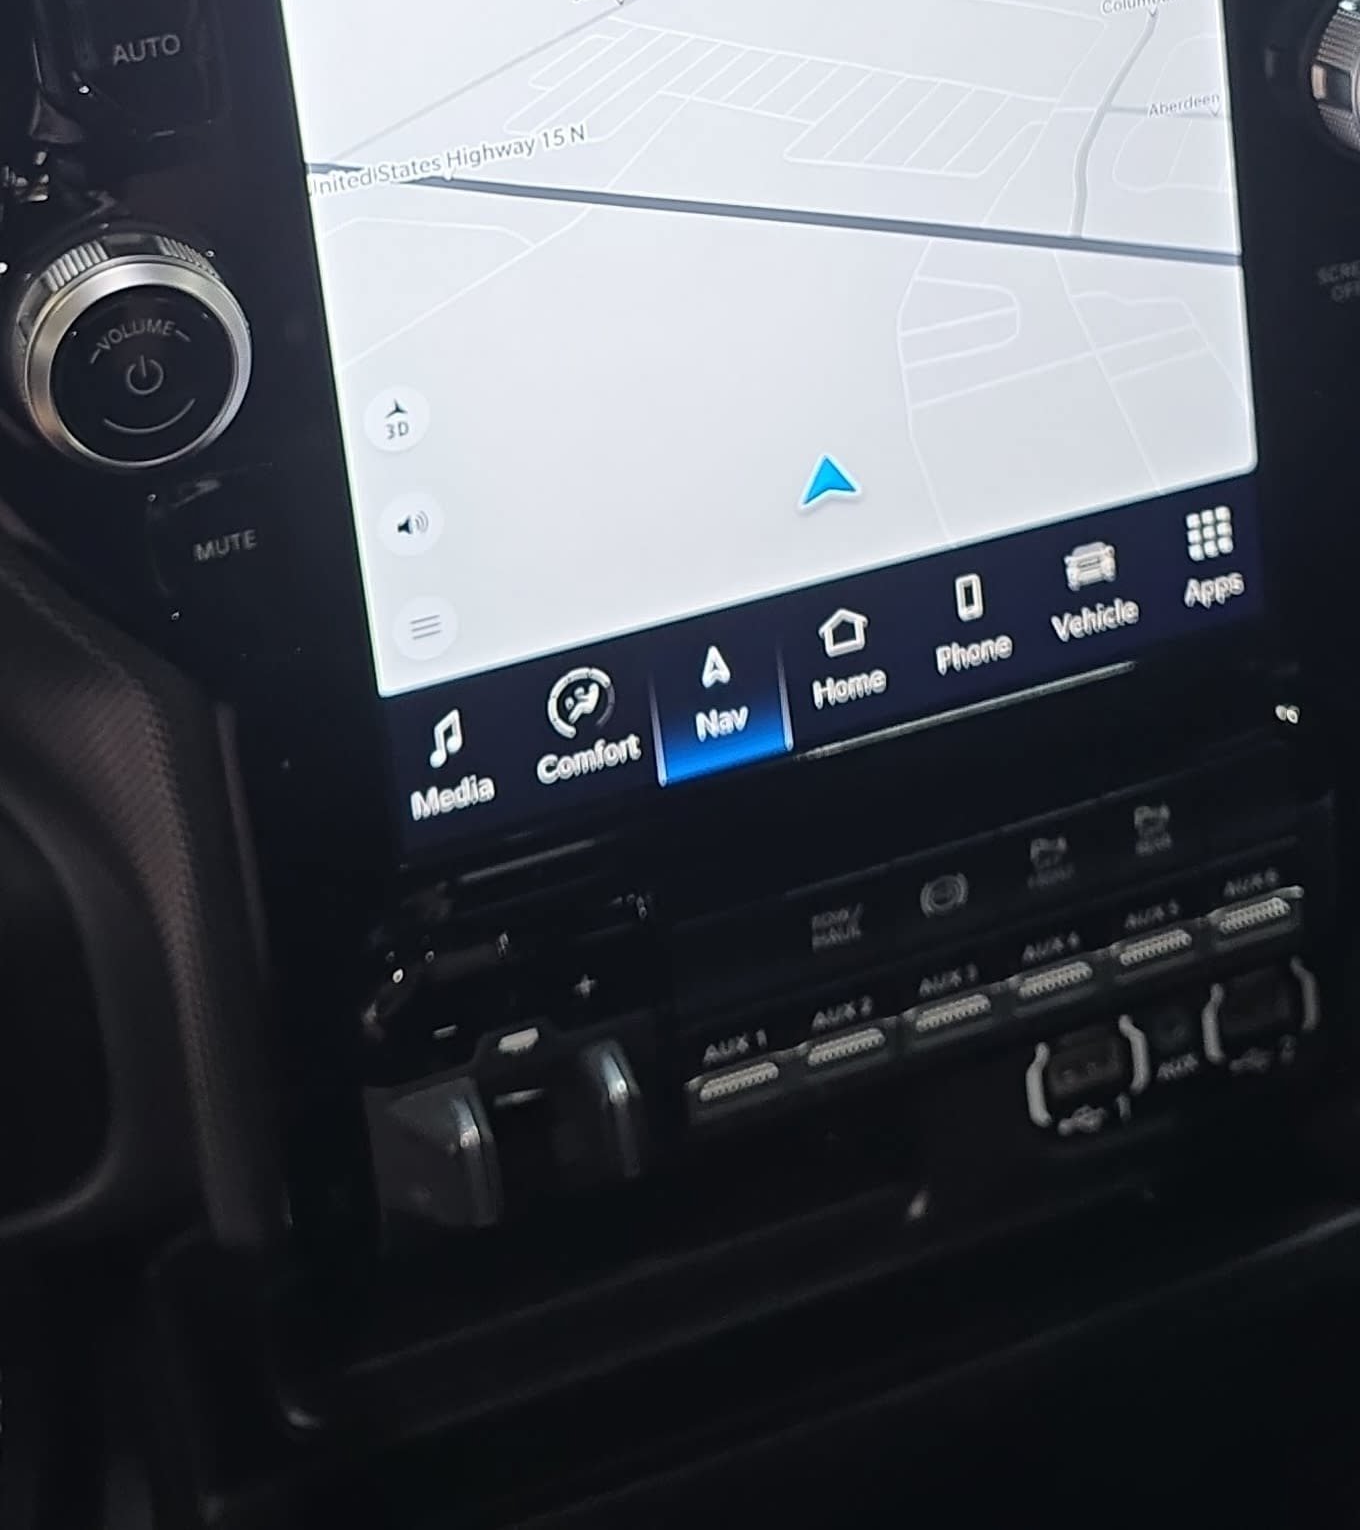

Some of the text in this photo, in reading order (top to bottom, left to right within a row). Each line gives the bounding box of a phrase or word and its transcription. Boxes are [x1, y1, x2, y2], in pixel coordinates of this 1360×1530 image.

[112, 34, 181, 67] AUTO
[1149, 93, 1220, 118] Aberdeen
[377, 157, 442, 182] States
[447, 138, 536, 168] Highway
[544, 130, 565, 149] 15
[570, 124, 586, 142] N
[96, 319, 175, 352] VOLUME
[386, 420, 410, 440] 3D
[194, 529, 258, 562] MUTE
[1184, 569, 1245, 610] Apps
[1052, 595, 1139, 642] Vehicle
[935, 631, 1013, 676] Phone
[812, 667, 887, 708] Home
[696, 702, 748, 738] Nav
[536, 733, 641, 786] Comfort
[410, 770, 496, 822] Media
[811, 1001, 857, 1031] AUX
[703, 1028, 768, 1065] AUX 1
